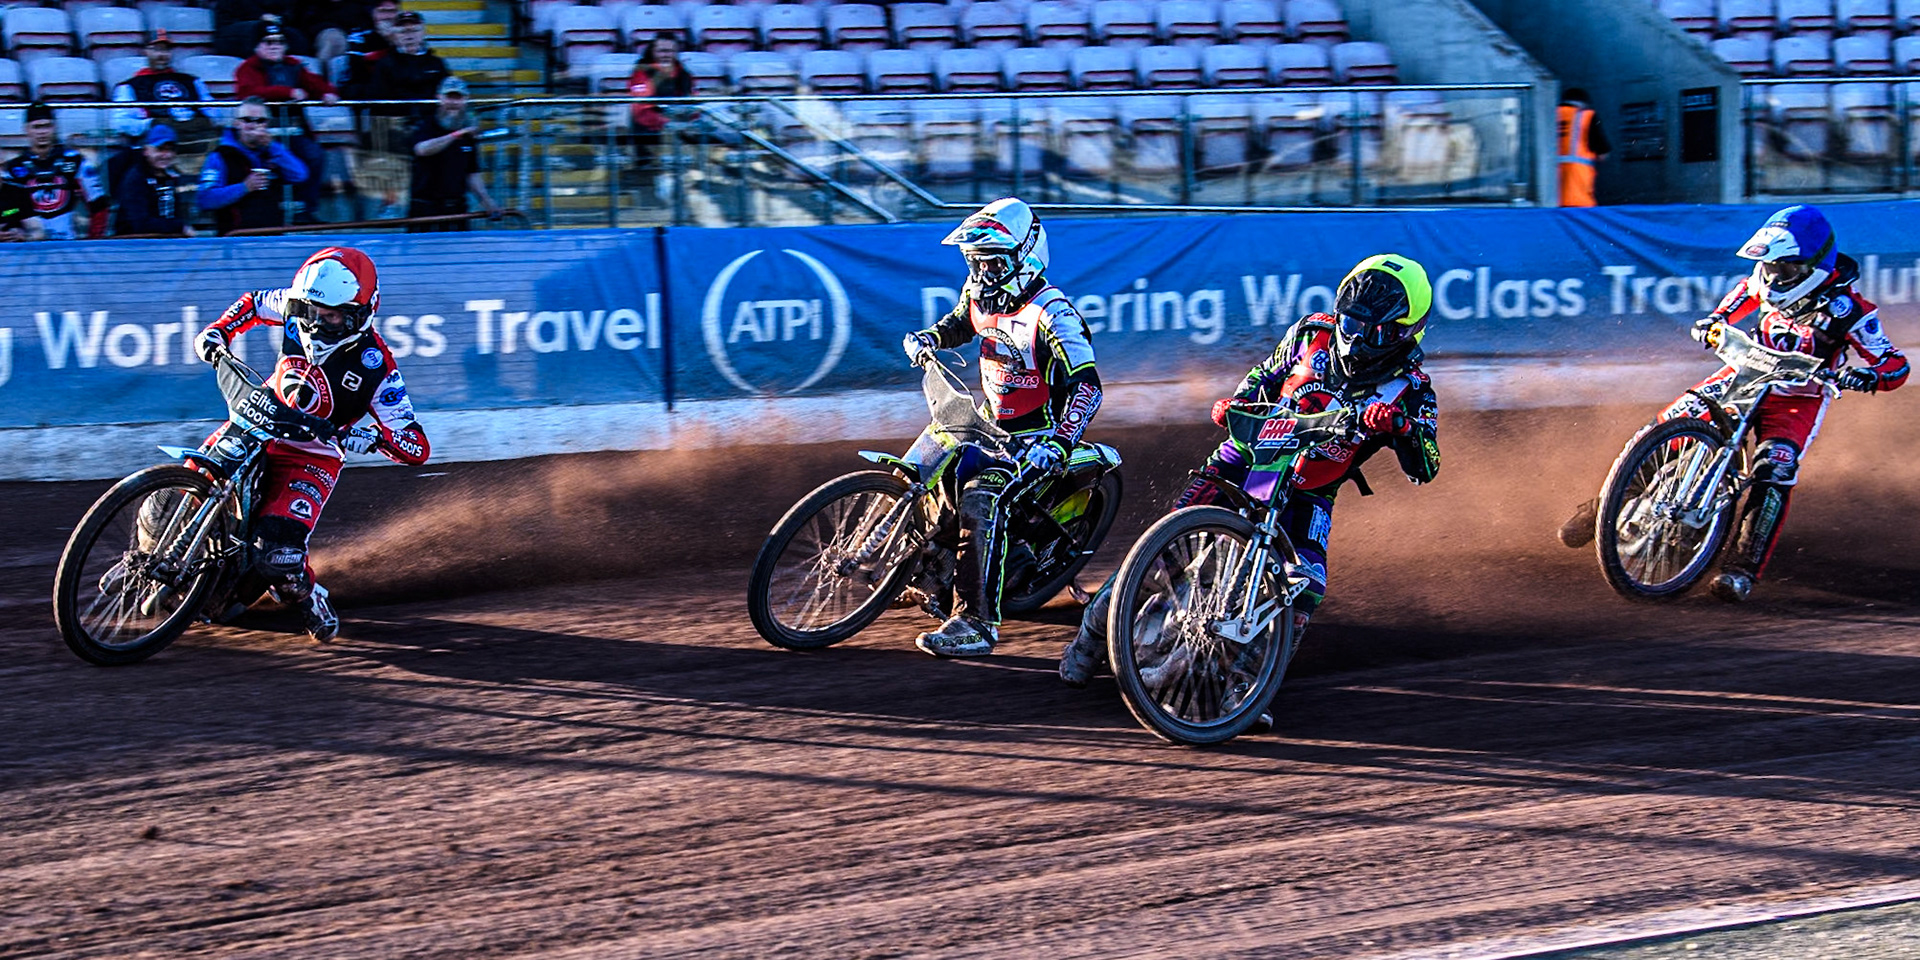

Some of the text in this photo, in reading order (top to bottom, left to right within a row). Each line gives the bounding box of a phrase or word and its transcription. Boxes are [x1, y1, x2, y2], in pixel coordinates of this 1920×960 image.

[1436, 266, 1586, 320] Class
[465, 292, 661, 354] Travel
[727, 298, 823, 344] ATPI
[236, 398, 275, 431] Floors
[249, 389, 278, 415] Elite
[1667, 397, 1694, 419] JACK
[1688, 406, 1701, 418] &
[1769, 449, 1793, 460] STS
